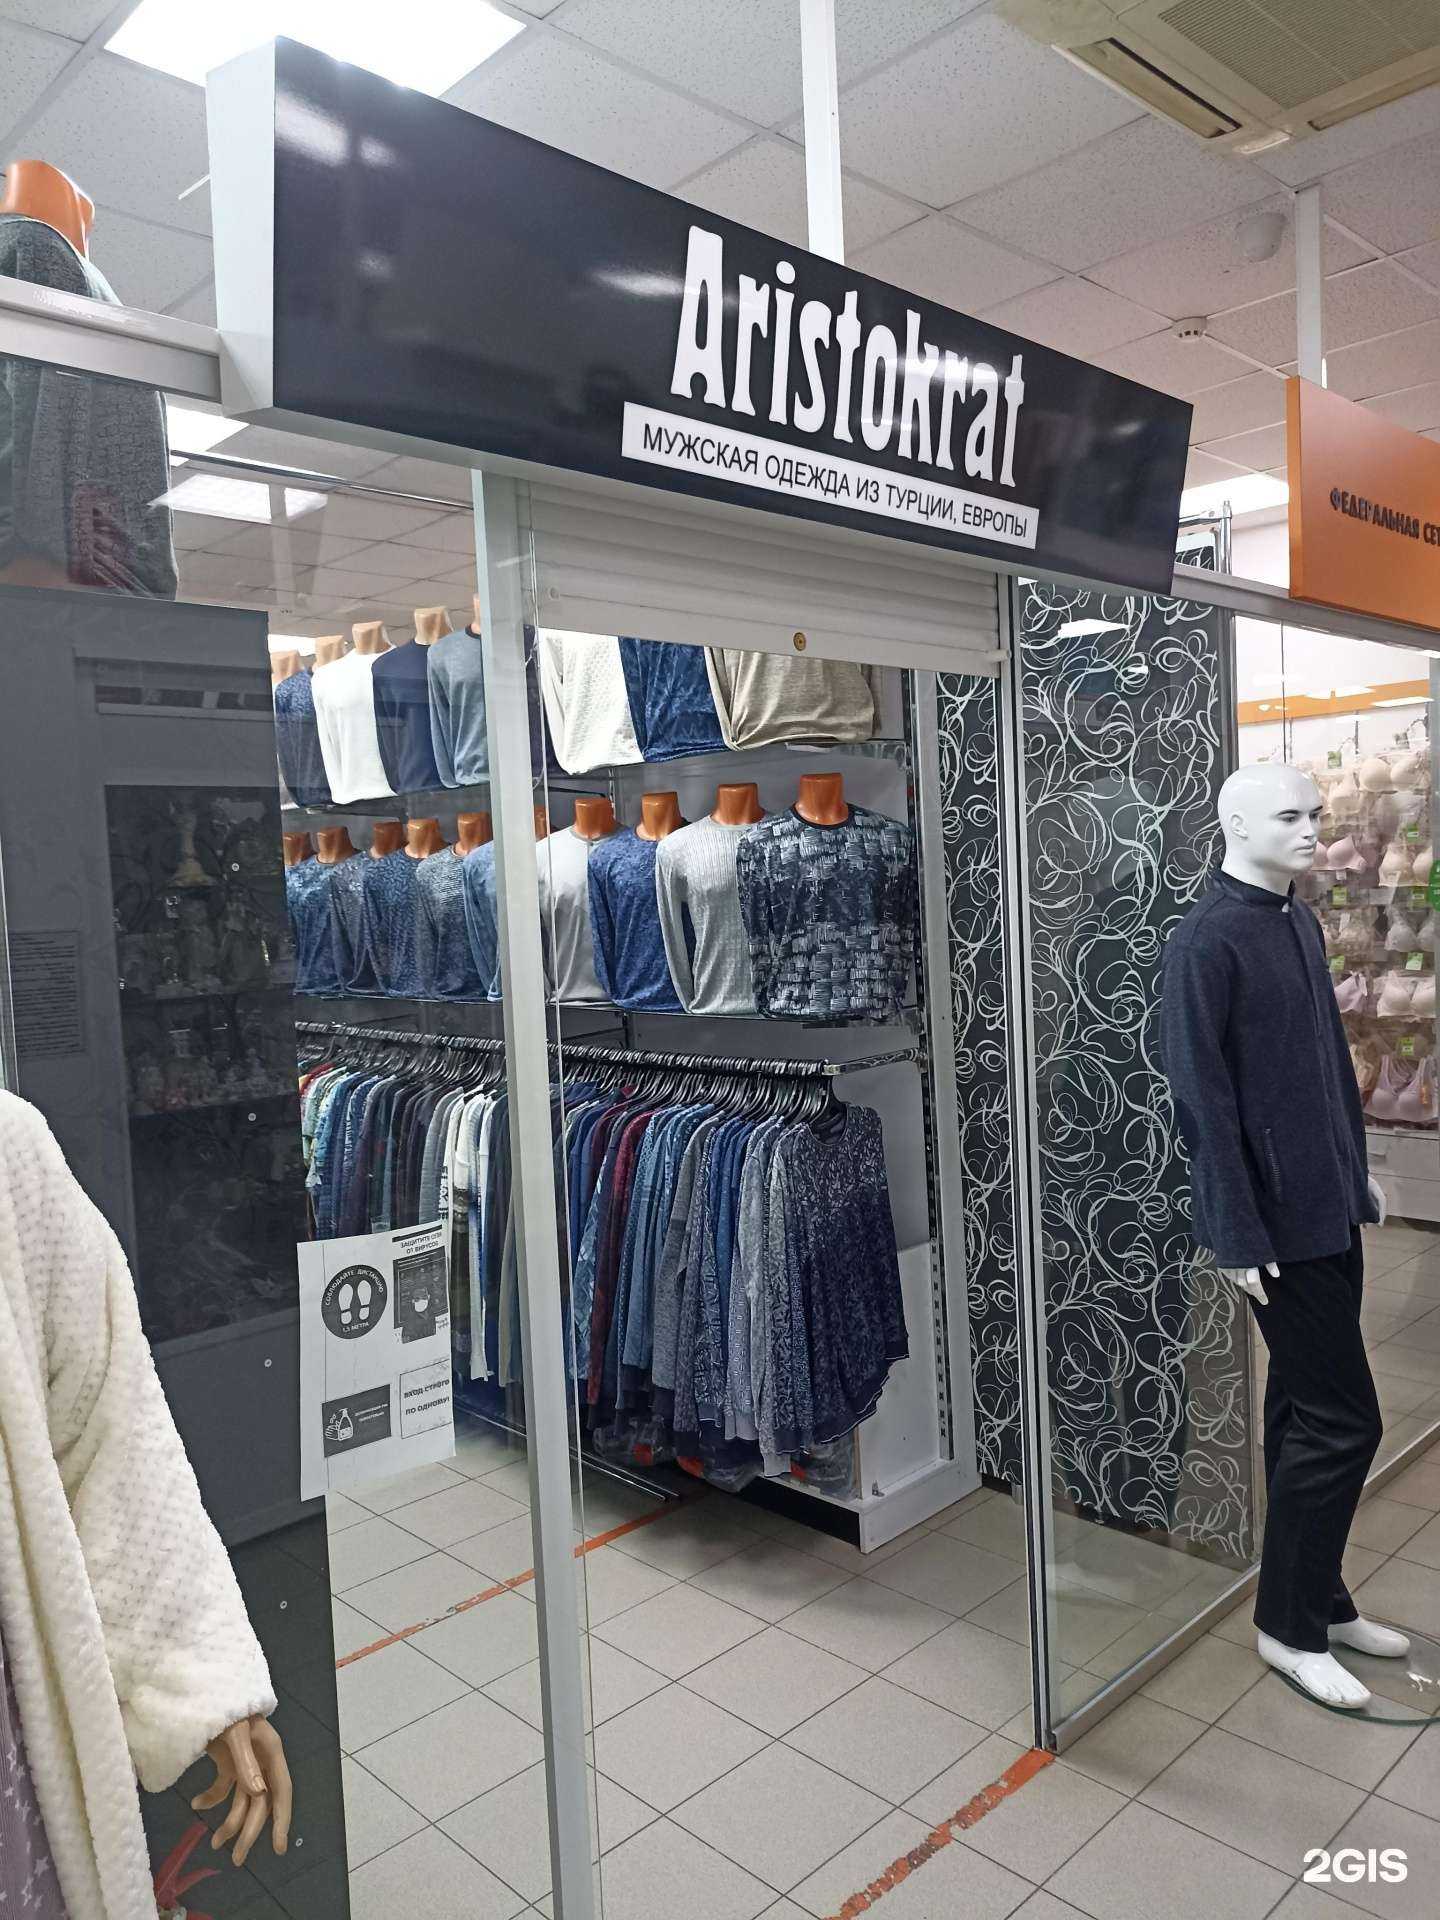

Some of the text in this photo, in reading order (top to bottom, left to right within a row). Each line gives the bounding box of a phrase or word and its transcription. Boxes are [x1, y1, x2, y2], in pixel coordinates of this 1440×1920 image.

[670, 225, 1025, 488] Aristokrat
[643, 423, 1027, 538] МУЖСКАЯ ОДЕЖДА ИЗ ТУРЦИИ, ЕВРОПЫ
[1330, 488, 1419, 539] ФЕДЕРАЛЬНАЯ
[325, 1269, 384, 1306] СОБЛЮДАЙТЕ ДИСТАНЦИЮ
[404, 1388, 424, 1399] ВХОД
